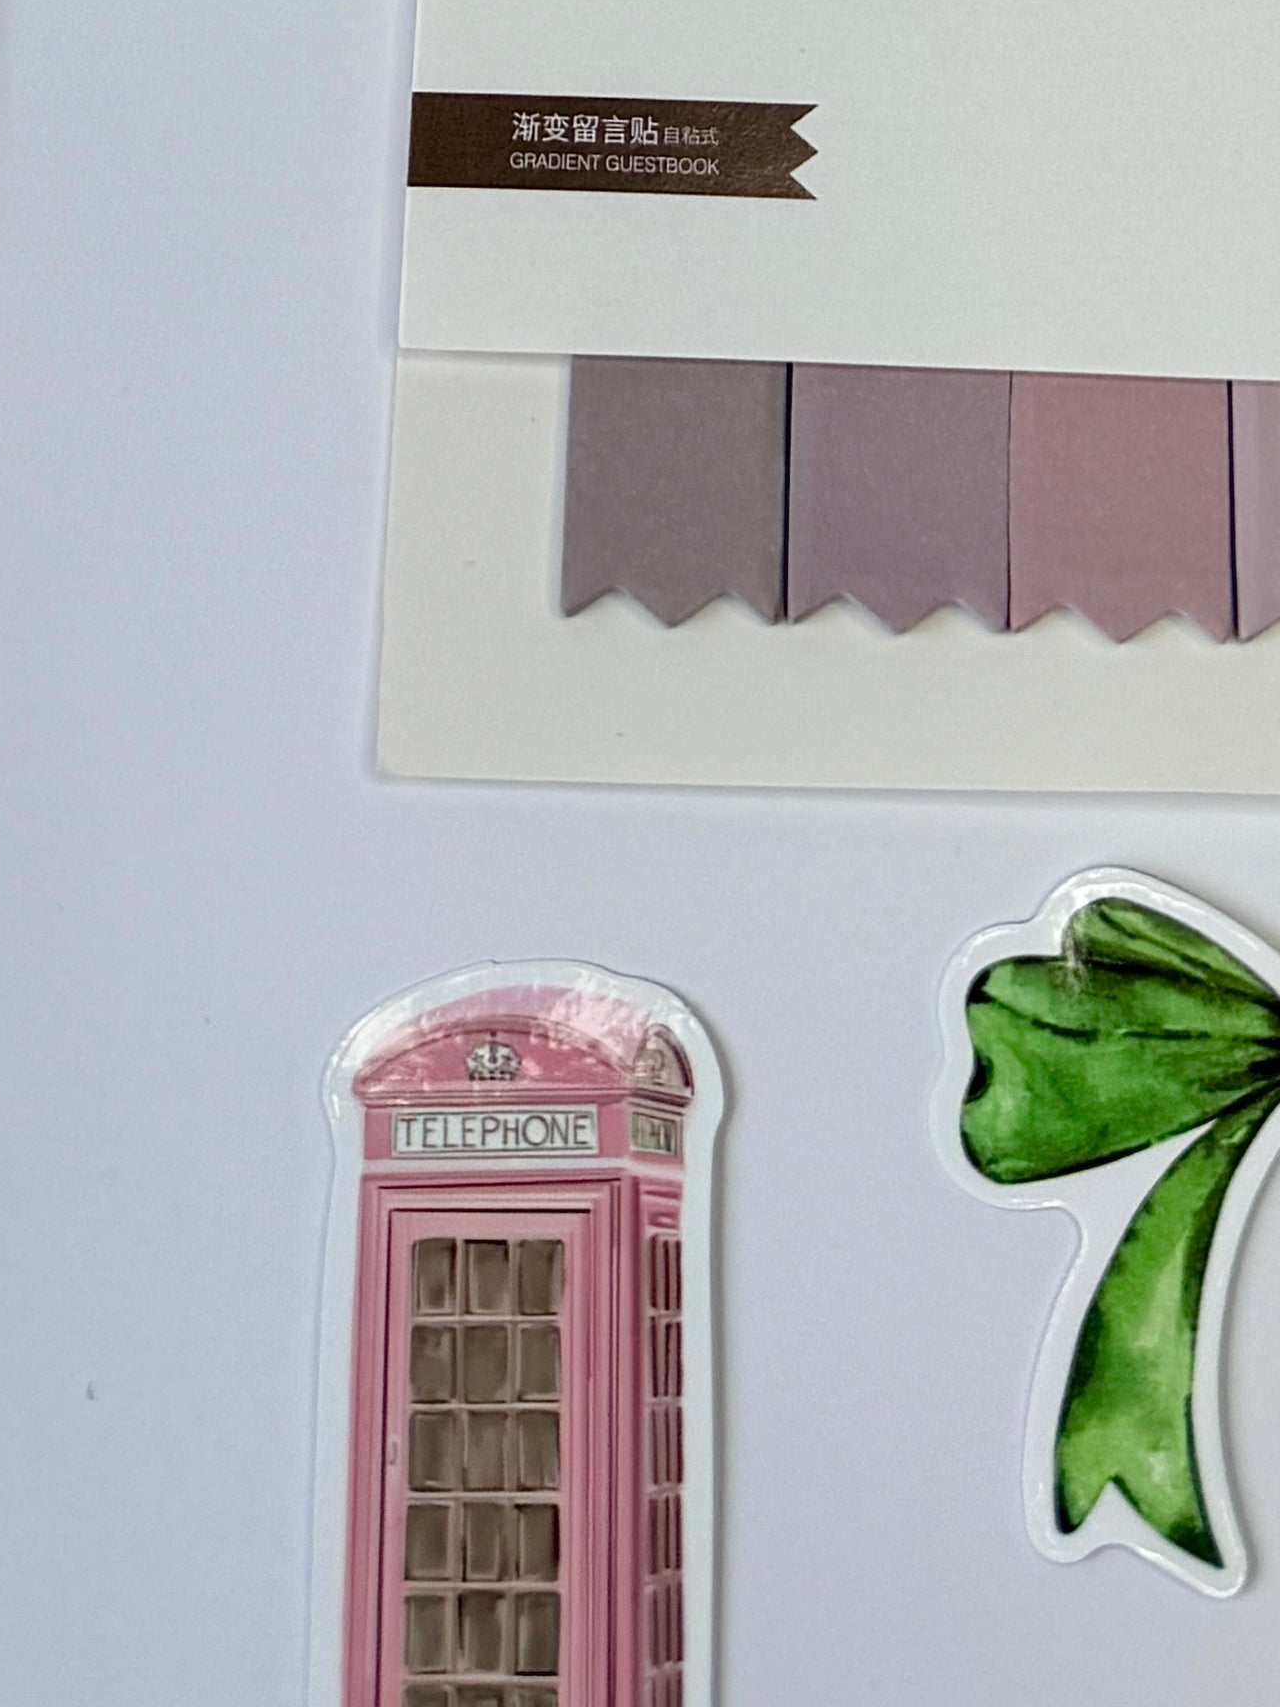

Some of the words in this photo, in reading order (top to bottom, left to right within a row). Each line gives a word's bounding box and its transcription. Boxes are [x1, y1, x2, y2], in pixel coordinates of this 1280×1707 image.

[511, 111, 659, 145] 渐变留言贴
[663, 126, 720, 147] 自粘式
[509, 151, 601, 172] GRADIENT
[606, 154, 720, 176] GUESTBOOK
[399, 1115, 590, 1148] TELEPHONE
